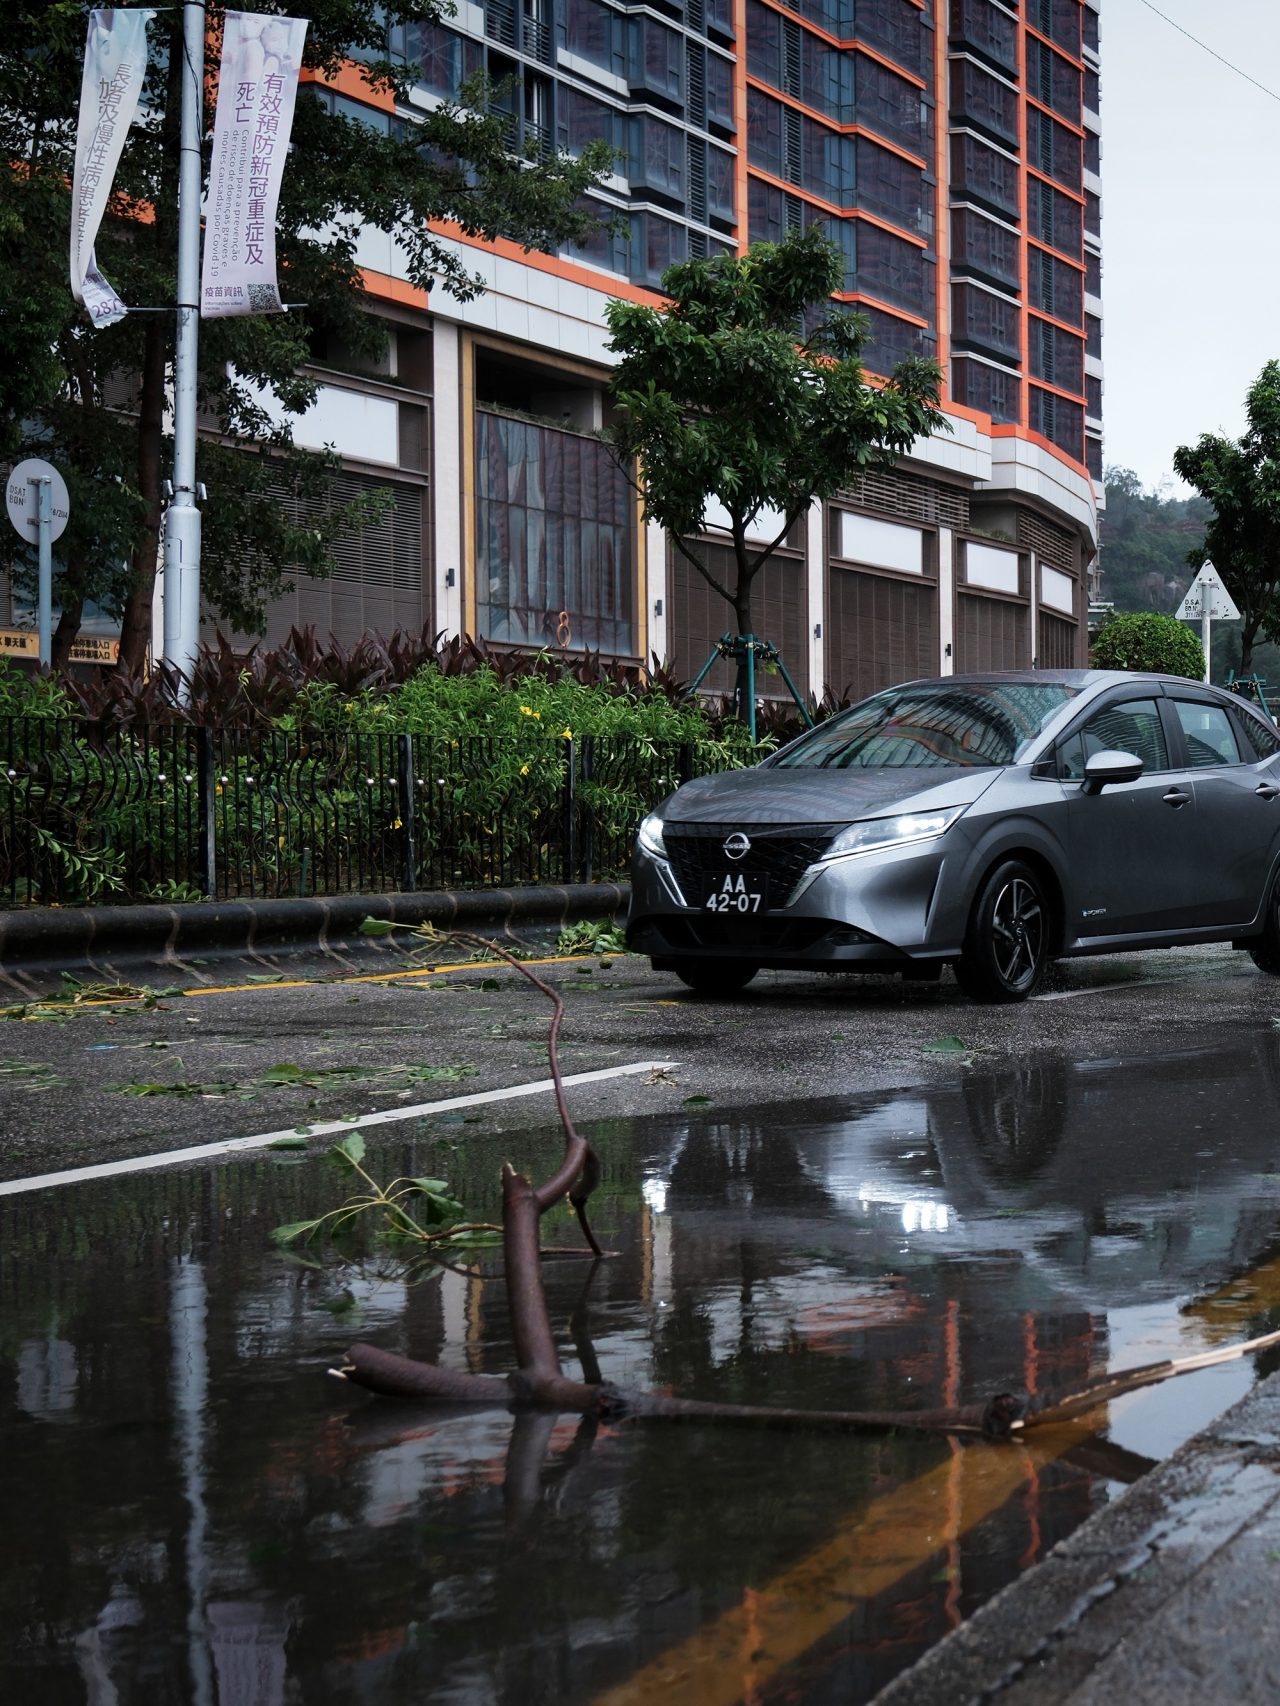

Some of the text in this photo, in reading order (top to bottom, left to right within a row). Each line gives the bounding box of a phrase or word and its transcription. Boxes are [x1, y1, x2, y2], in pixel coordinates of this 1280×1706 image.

[235, 82, 257, 123] 死亡
[232, 130, 239, 142] de
[239, 129, 249, 175] Contribui
[229, 144, 238, 168] risco
[245, 73, 286, 265] 有效預防新冠重症及
[211, 130, 229, 277] mortes causadas por Covid-19
[223, 183, 234, 225] doenças
[221, 227, 229, 259] graves
[231, 209, 241, 261] prevenção
[205, 286, 244, 298] 疫苗資訊
[722, 874, 746, 893] AA
[706, 894, 761, 912] 42-07
